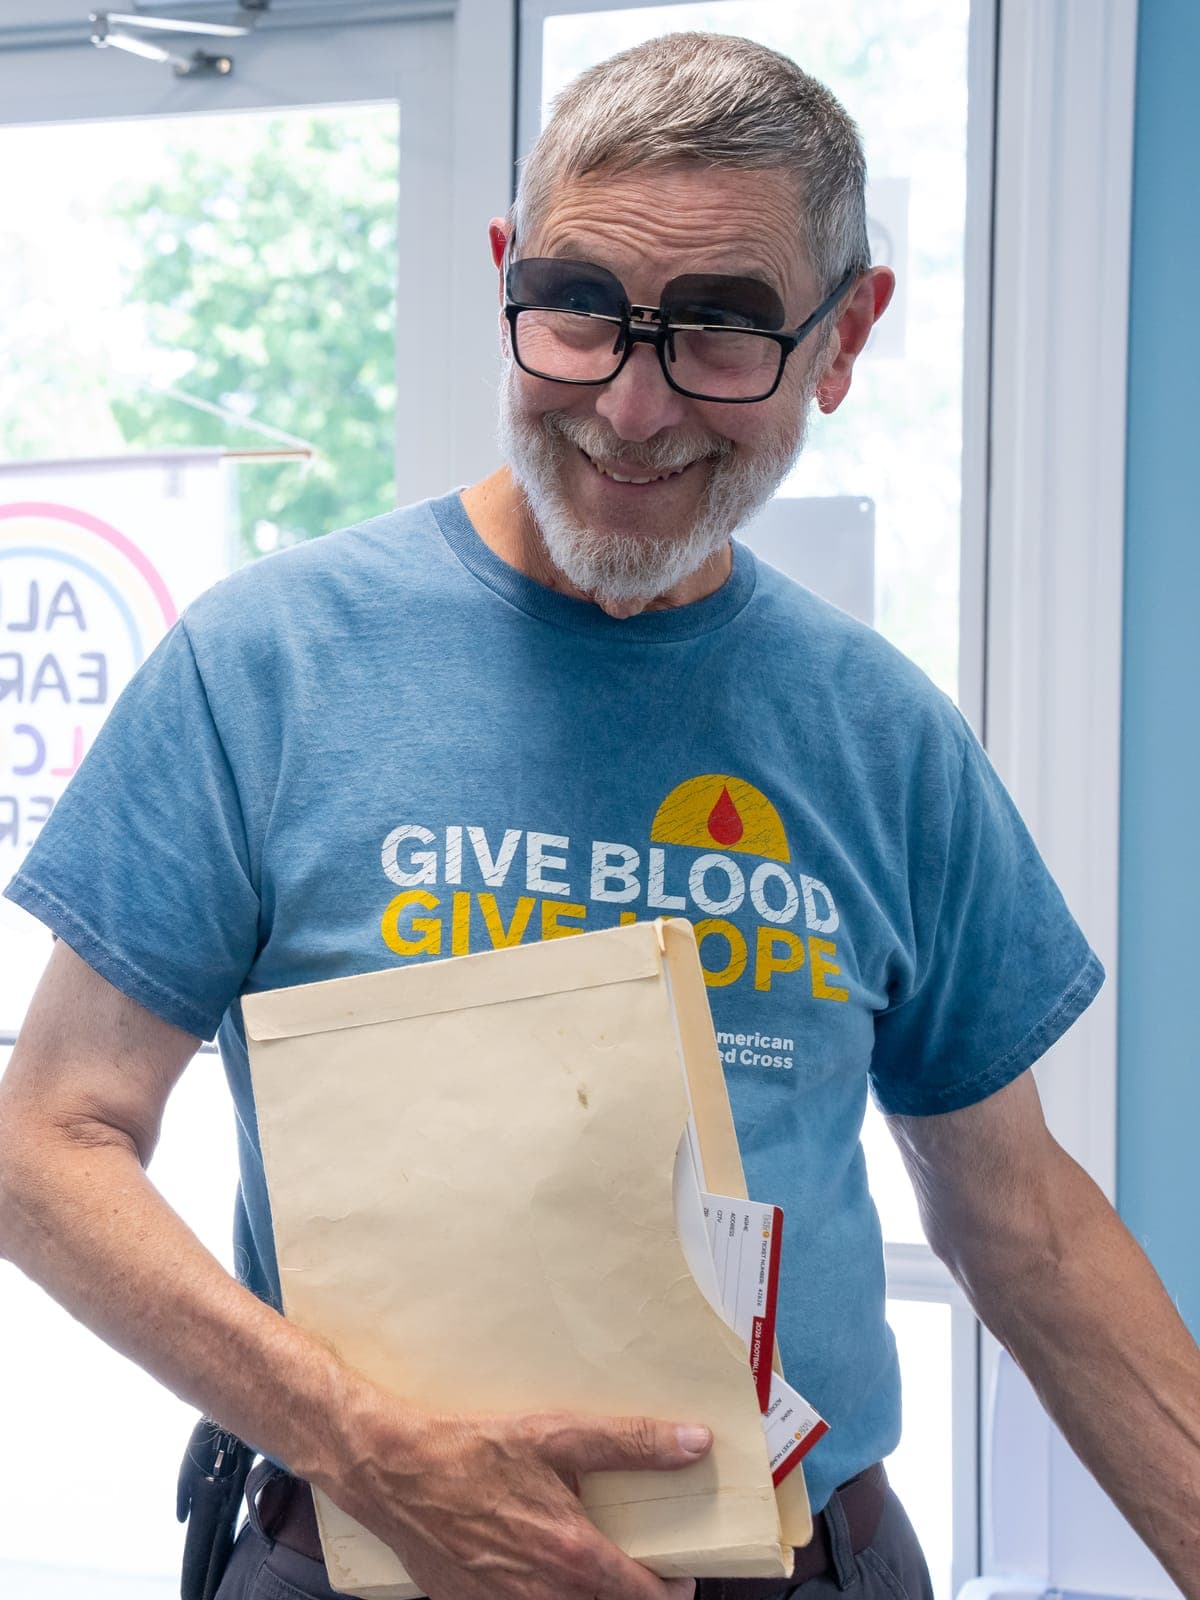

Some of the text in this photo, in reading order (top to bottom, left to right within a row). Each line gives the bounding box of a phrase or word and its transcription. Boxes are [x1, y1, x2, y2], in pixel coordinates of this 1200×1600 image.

[381, 824, 840, 933] GIVE BLOOD
[619, 910, 849, 1003] OPE
[717, 1031, 794, 1051] merican
[740, 1049, 794, 1069] Cross
